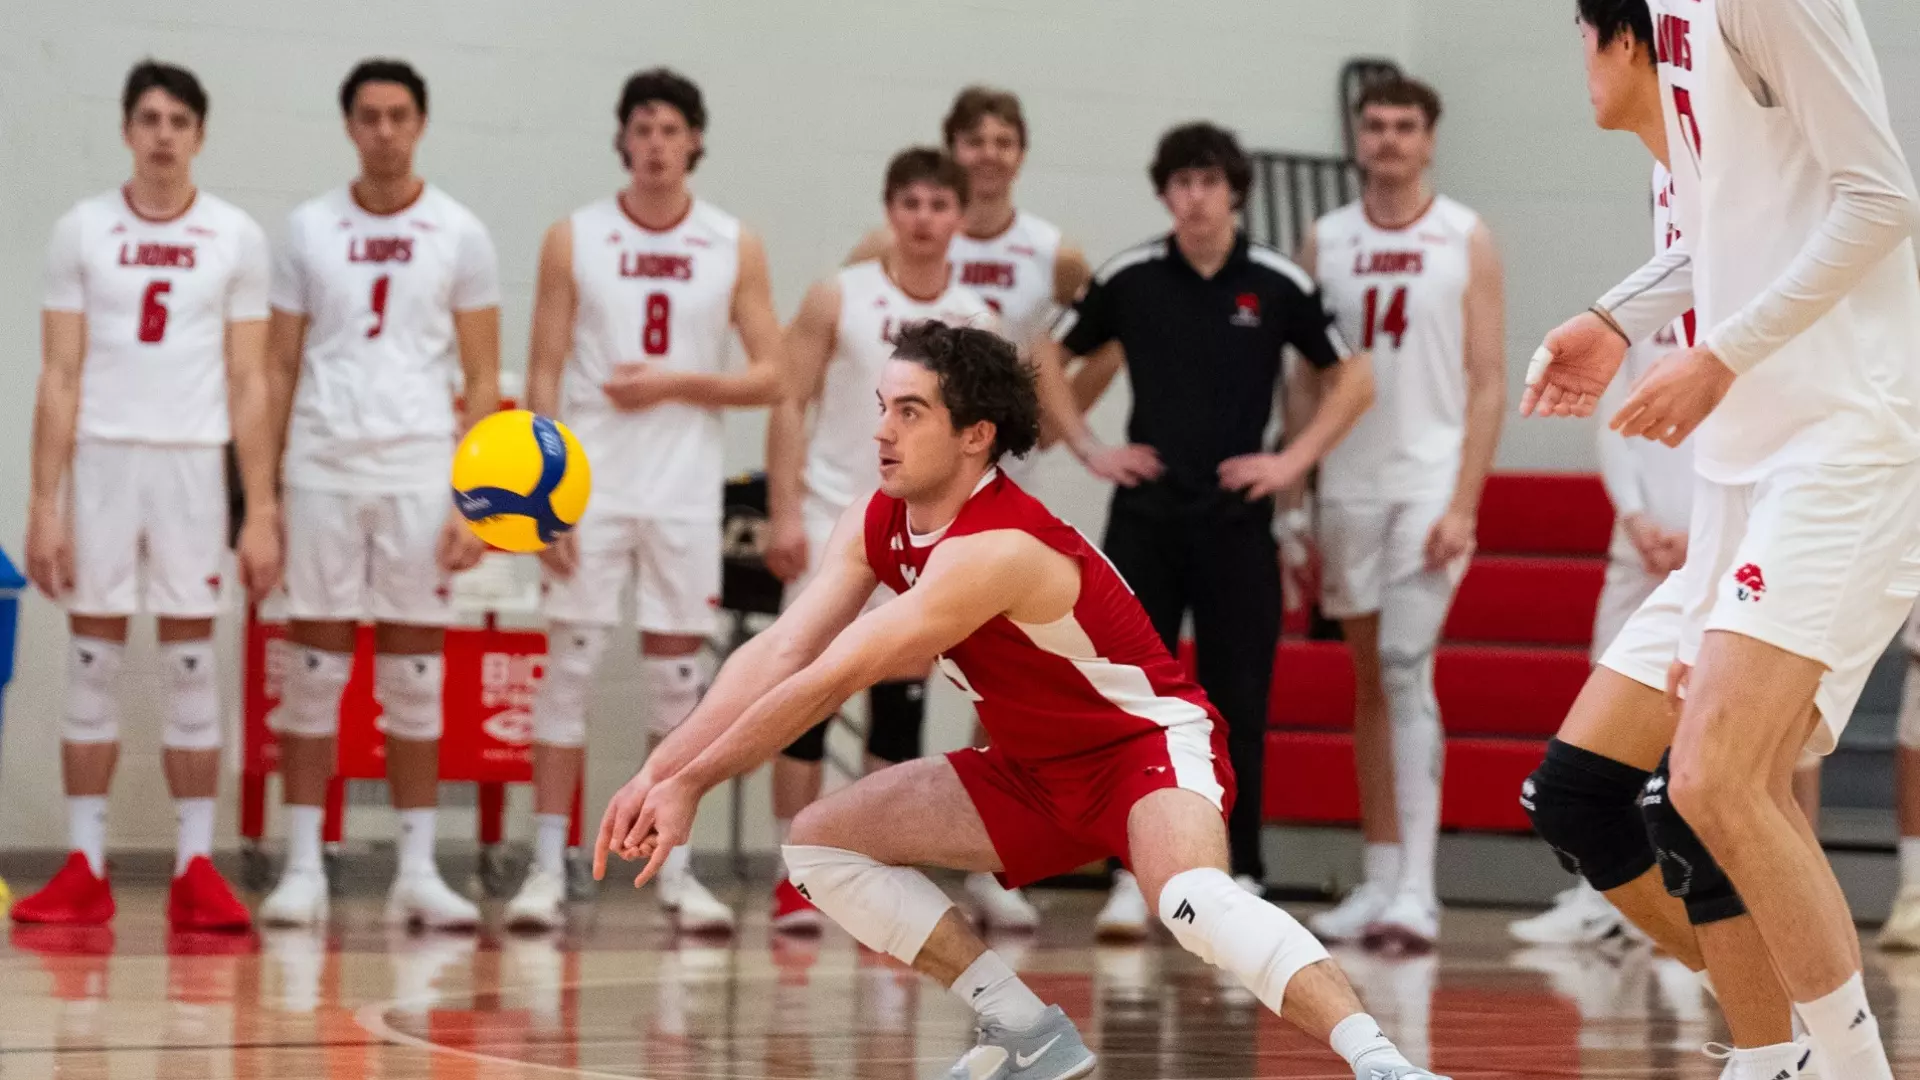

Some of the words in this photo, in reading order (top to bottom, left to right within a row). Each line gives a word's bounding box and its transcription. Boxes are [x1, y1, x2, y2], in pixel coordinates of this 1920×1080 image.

[117, 242, 196, 269] LIONS
[347, 236, 413, 264] LIONS
[1353, 250, 1424, 276] LIONS
[619, 250, 692, 281] LIONS
[960, 261, 1016, 289] IONS
[137, 280, 171, 343] 6
[642, 292, 670, 356] 8
[1362, 286, 1408, 350] 14
